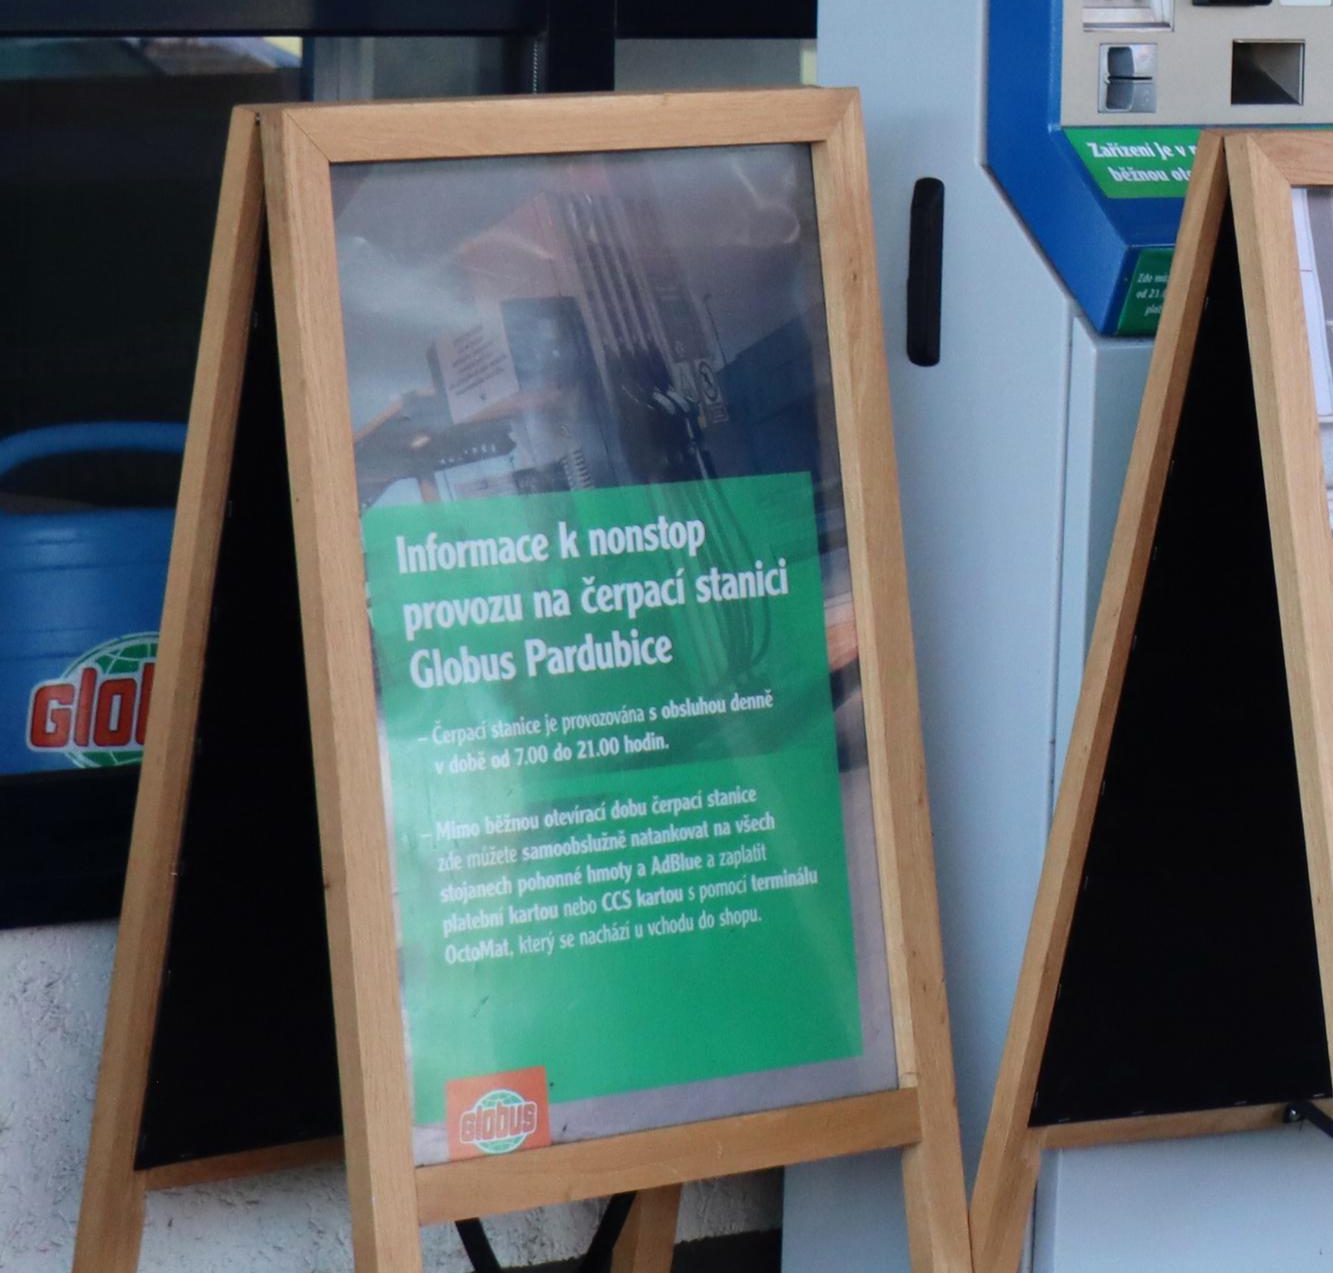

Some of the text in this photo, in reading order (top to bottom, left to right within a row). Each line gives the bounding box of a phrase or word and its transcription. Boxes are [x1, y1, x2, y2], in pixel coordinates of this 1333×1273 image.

[1087, 141, 1186, 161] Zařízení je v
[1108, 166, 1170, 183] běžnou
[397, 515, 705, 573] Informace k nonstop
[404, 558, 789, 641] provozu na čerpací stanici
[410, 628, 673, 688] Globus Pardubice
[430, 689, 773, 747] Čerpací stanice je provozována s obsluhou denně
[434, 730, 669, 775] v době od 7.00 do 21.00 hodin.
[435, 786, 757, 841] Mimo běžnou otevírací dobu čerpací stanice
[437, 811, 775, 872] zde můžete samoobslužně natankovat na všech
[440, 844, 766, 905] stojanech pohonné hmoty a AdBlue a zaplatit
[442, 866, 818, 937] platební kartou nebo CCS kartou s pomocí terminálu
[446, 908, 762, 963] OctoMat, který se nachází u vchodu do shopu.
